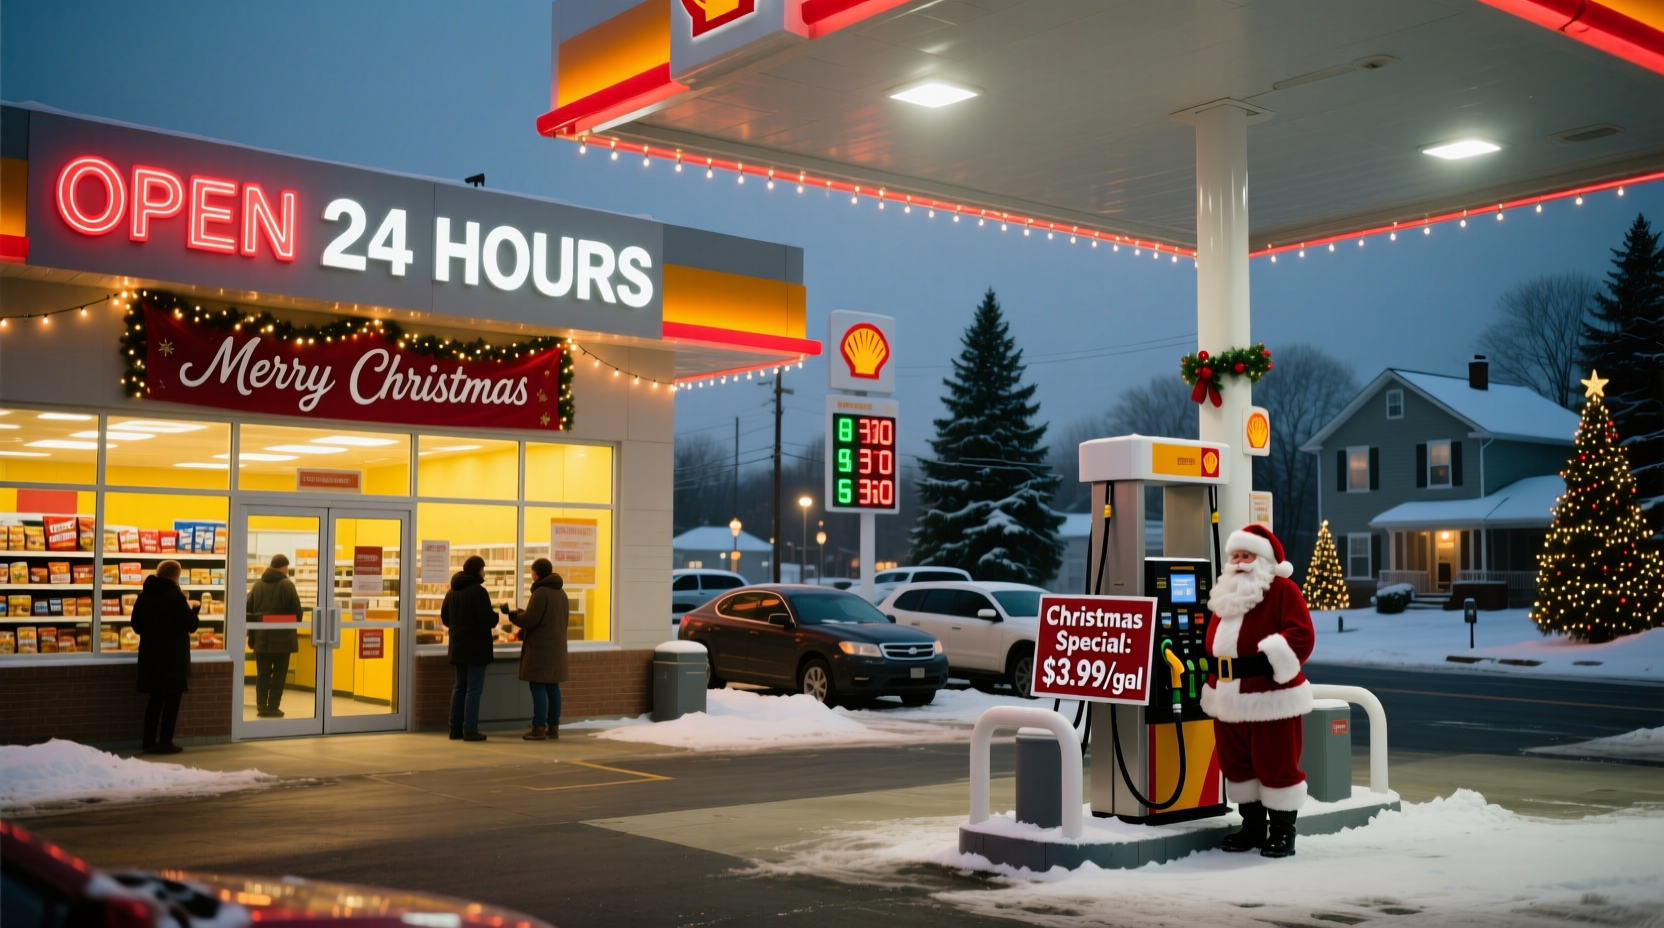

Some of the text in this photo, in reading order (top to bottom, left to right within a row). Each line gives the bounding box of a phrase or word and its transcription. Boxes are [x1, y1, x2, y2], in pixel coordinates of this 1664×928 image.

[55, 155, 655, 309] OPEN 24 HOURS
[178, 335, 529, 412] Merry Christmas
[1046, 605, 1143, 629] Christmas
[1055, 630, 1133, 656] Special:
[1042, 656, 1143, 695] $3.99/gal
